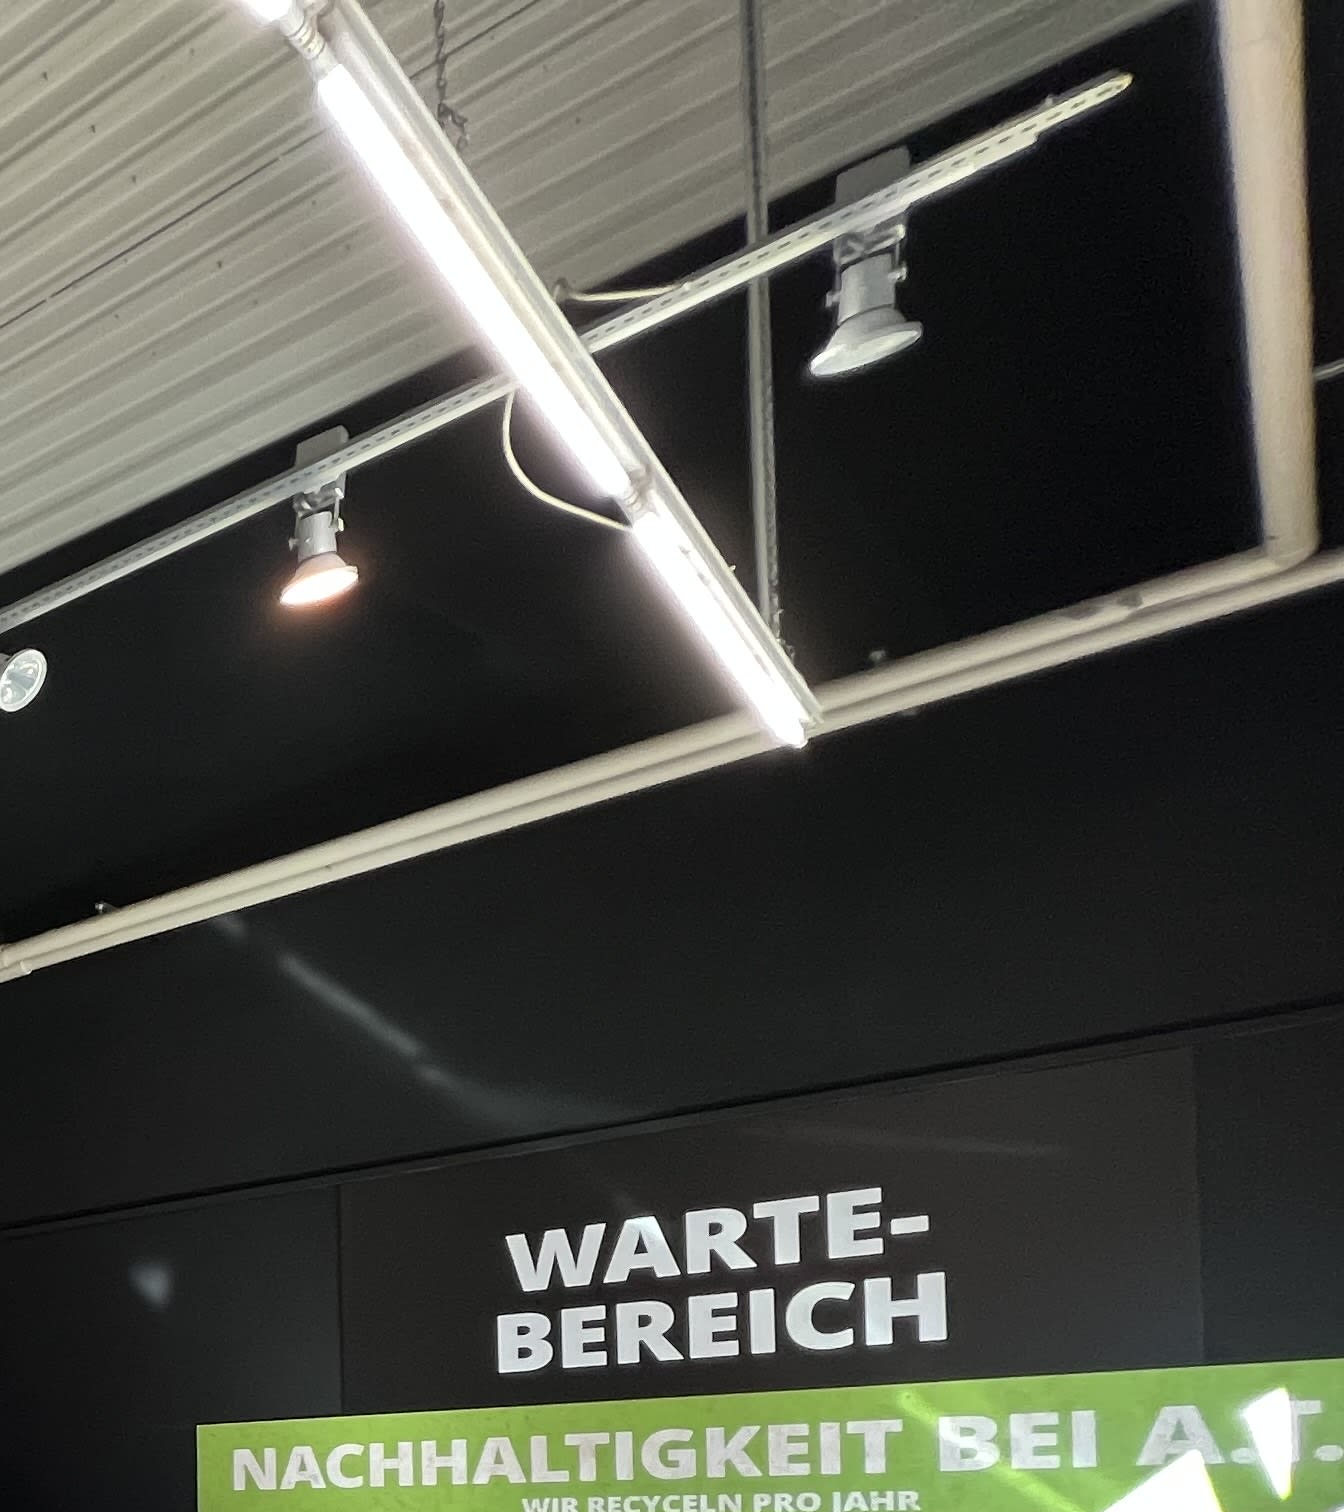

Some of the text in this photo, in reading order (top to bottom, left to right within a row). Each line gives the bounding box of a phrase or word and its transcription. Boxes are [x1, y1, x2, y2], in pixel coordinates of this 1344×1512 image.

[505, 1186, 930, 1293] WARTE-
[496, 1271, 948, 1374] BEREICH
[231, 1418, 904, 1492] NACHHALTIGKEIT
[938, 1409, 1098, 1473] BEI
